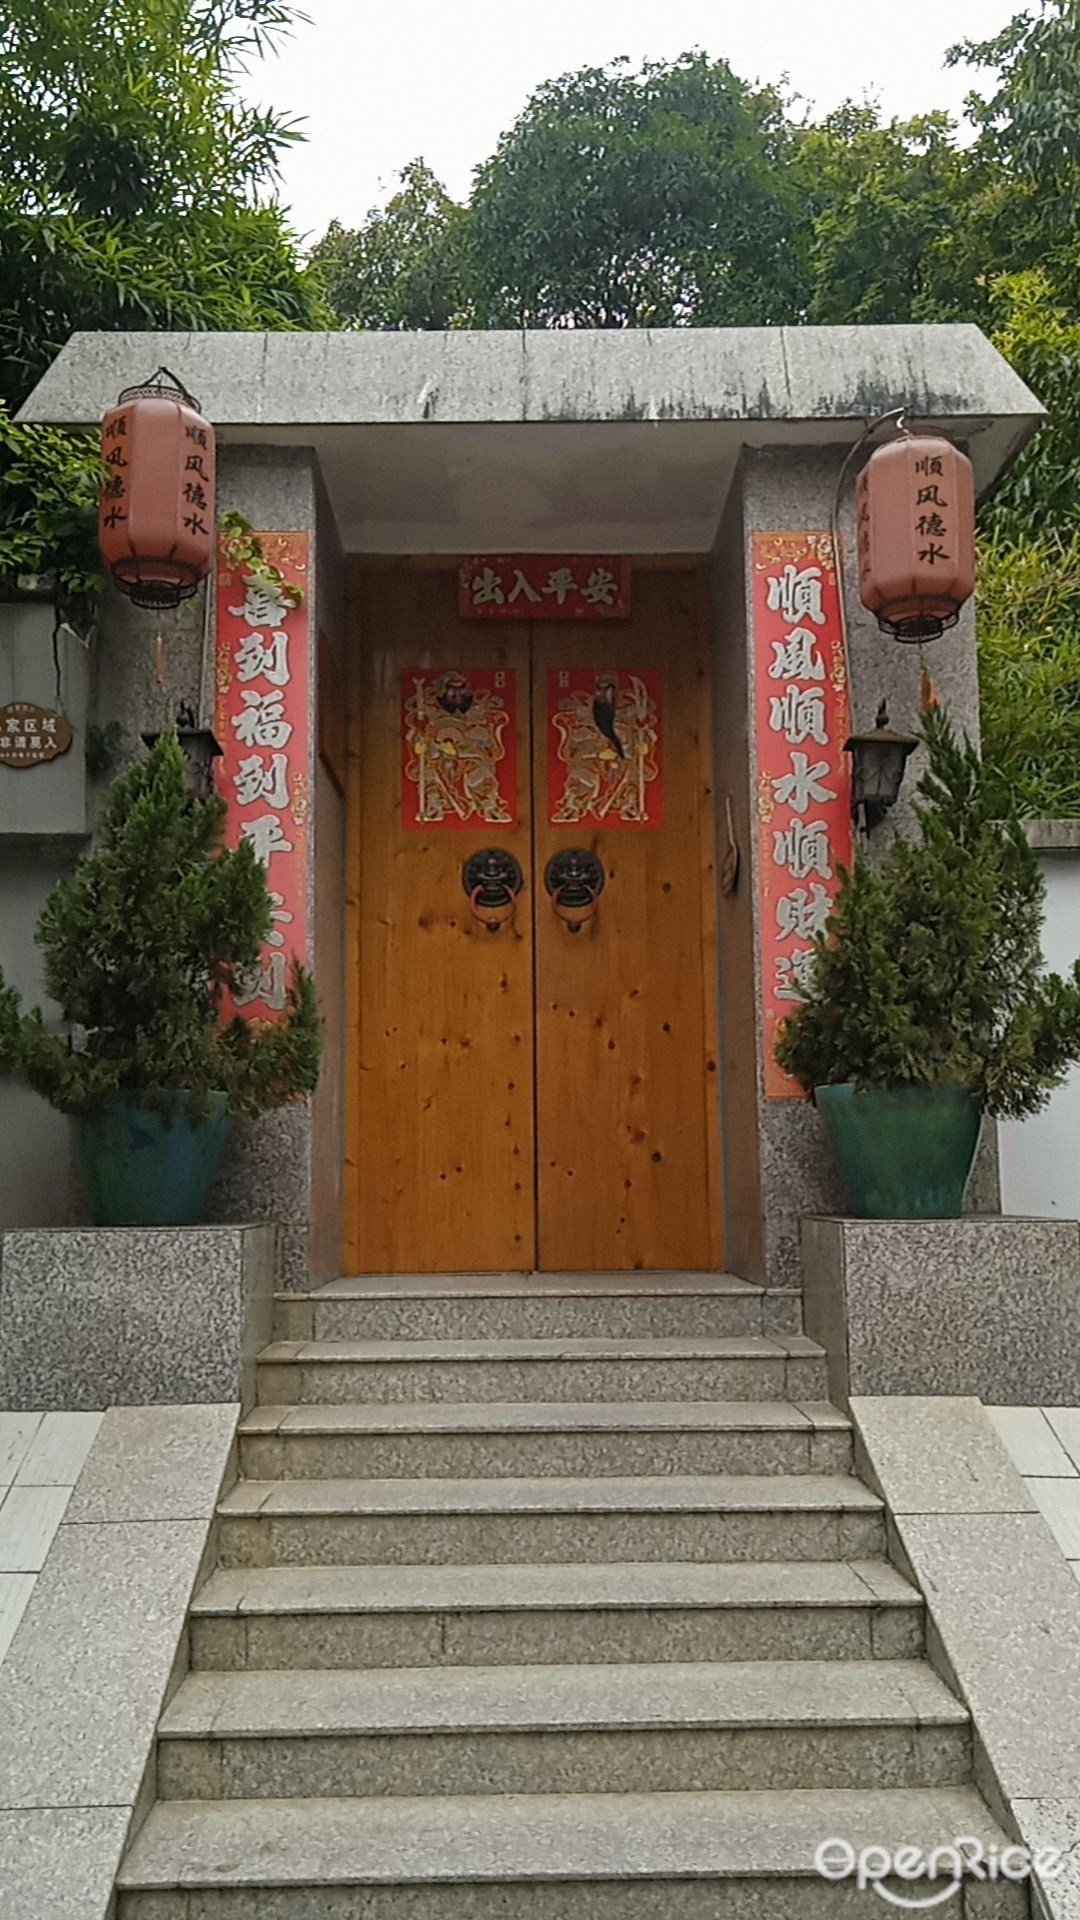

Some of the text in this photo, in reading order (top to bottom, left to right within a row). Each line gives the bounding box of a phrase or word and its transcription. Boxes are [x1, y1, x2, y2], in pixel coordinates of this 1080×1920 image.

[472, 567, 618, 605] 出入平安
[0, 717, 57, 733] 家区域
